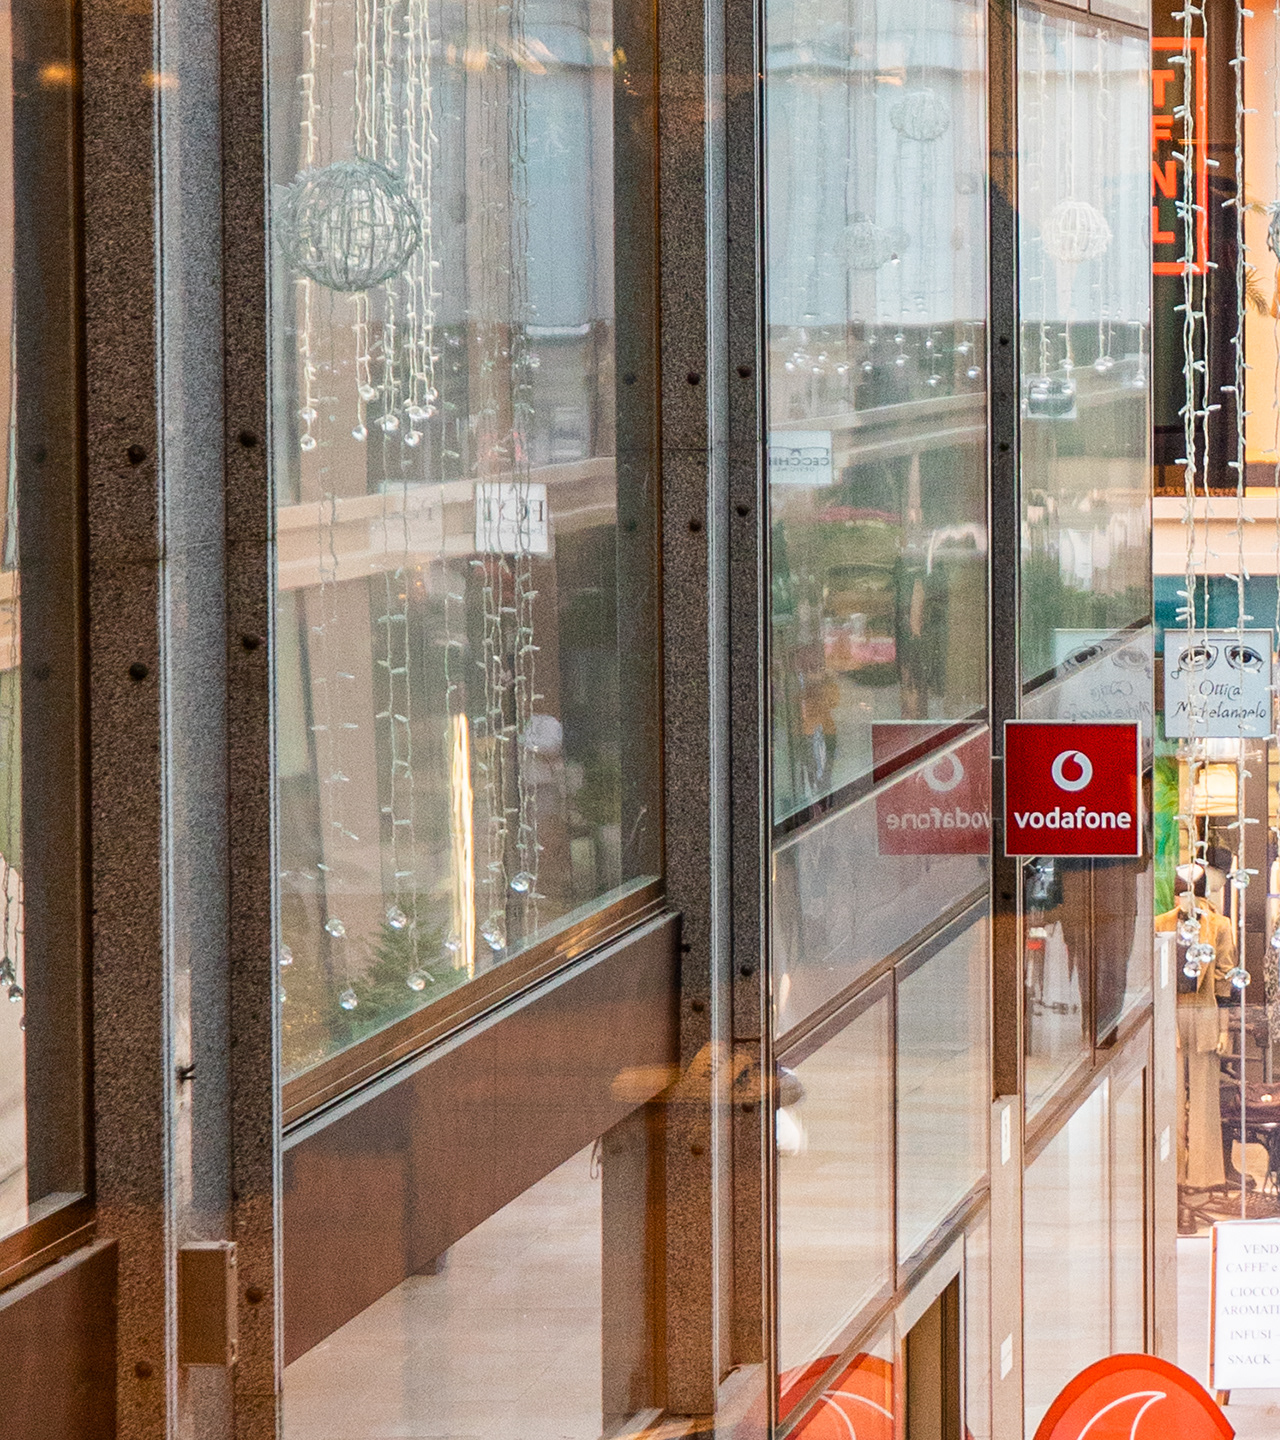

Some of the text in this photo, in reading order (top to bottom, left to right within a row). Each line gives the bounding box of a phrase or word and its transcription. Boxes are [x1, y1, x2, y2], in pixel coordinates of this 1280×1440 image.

[1013, 806, 1132, 829] vodafone
[1230, 1329, 1272, 1340] INFUSI
[1228, 1355, 1271, 1364] SNACK
